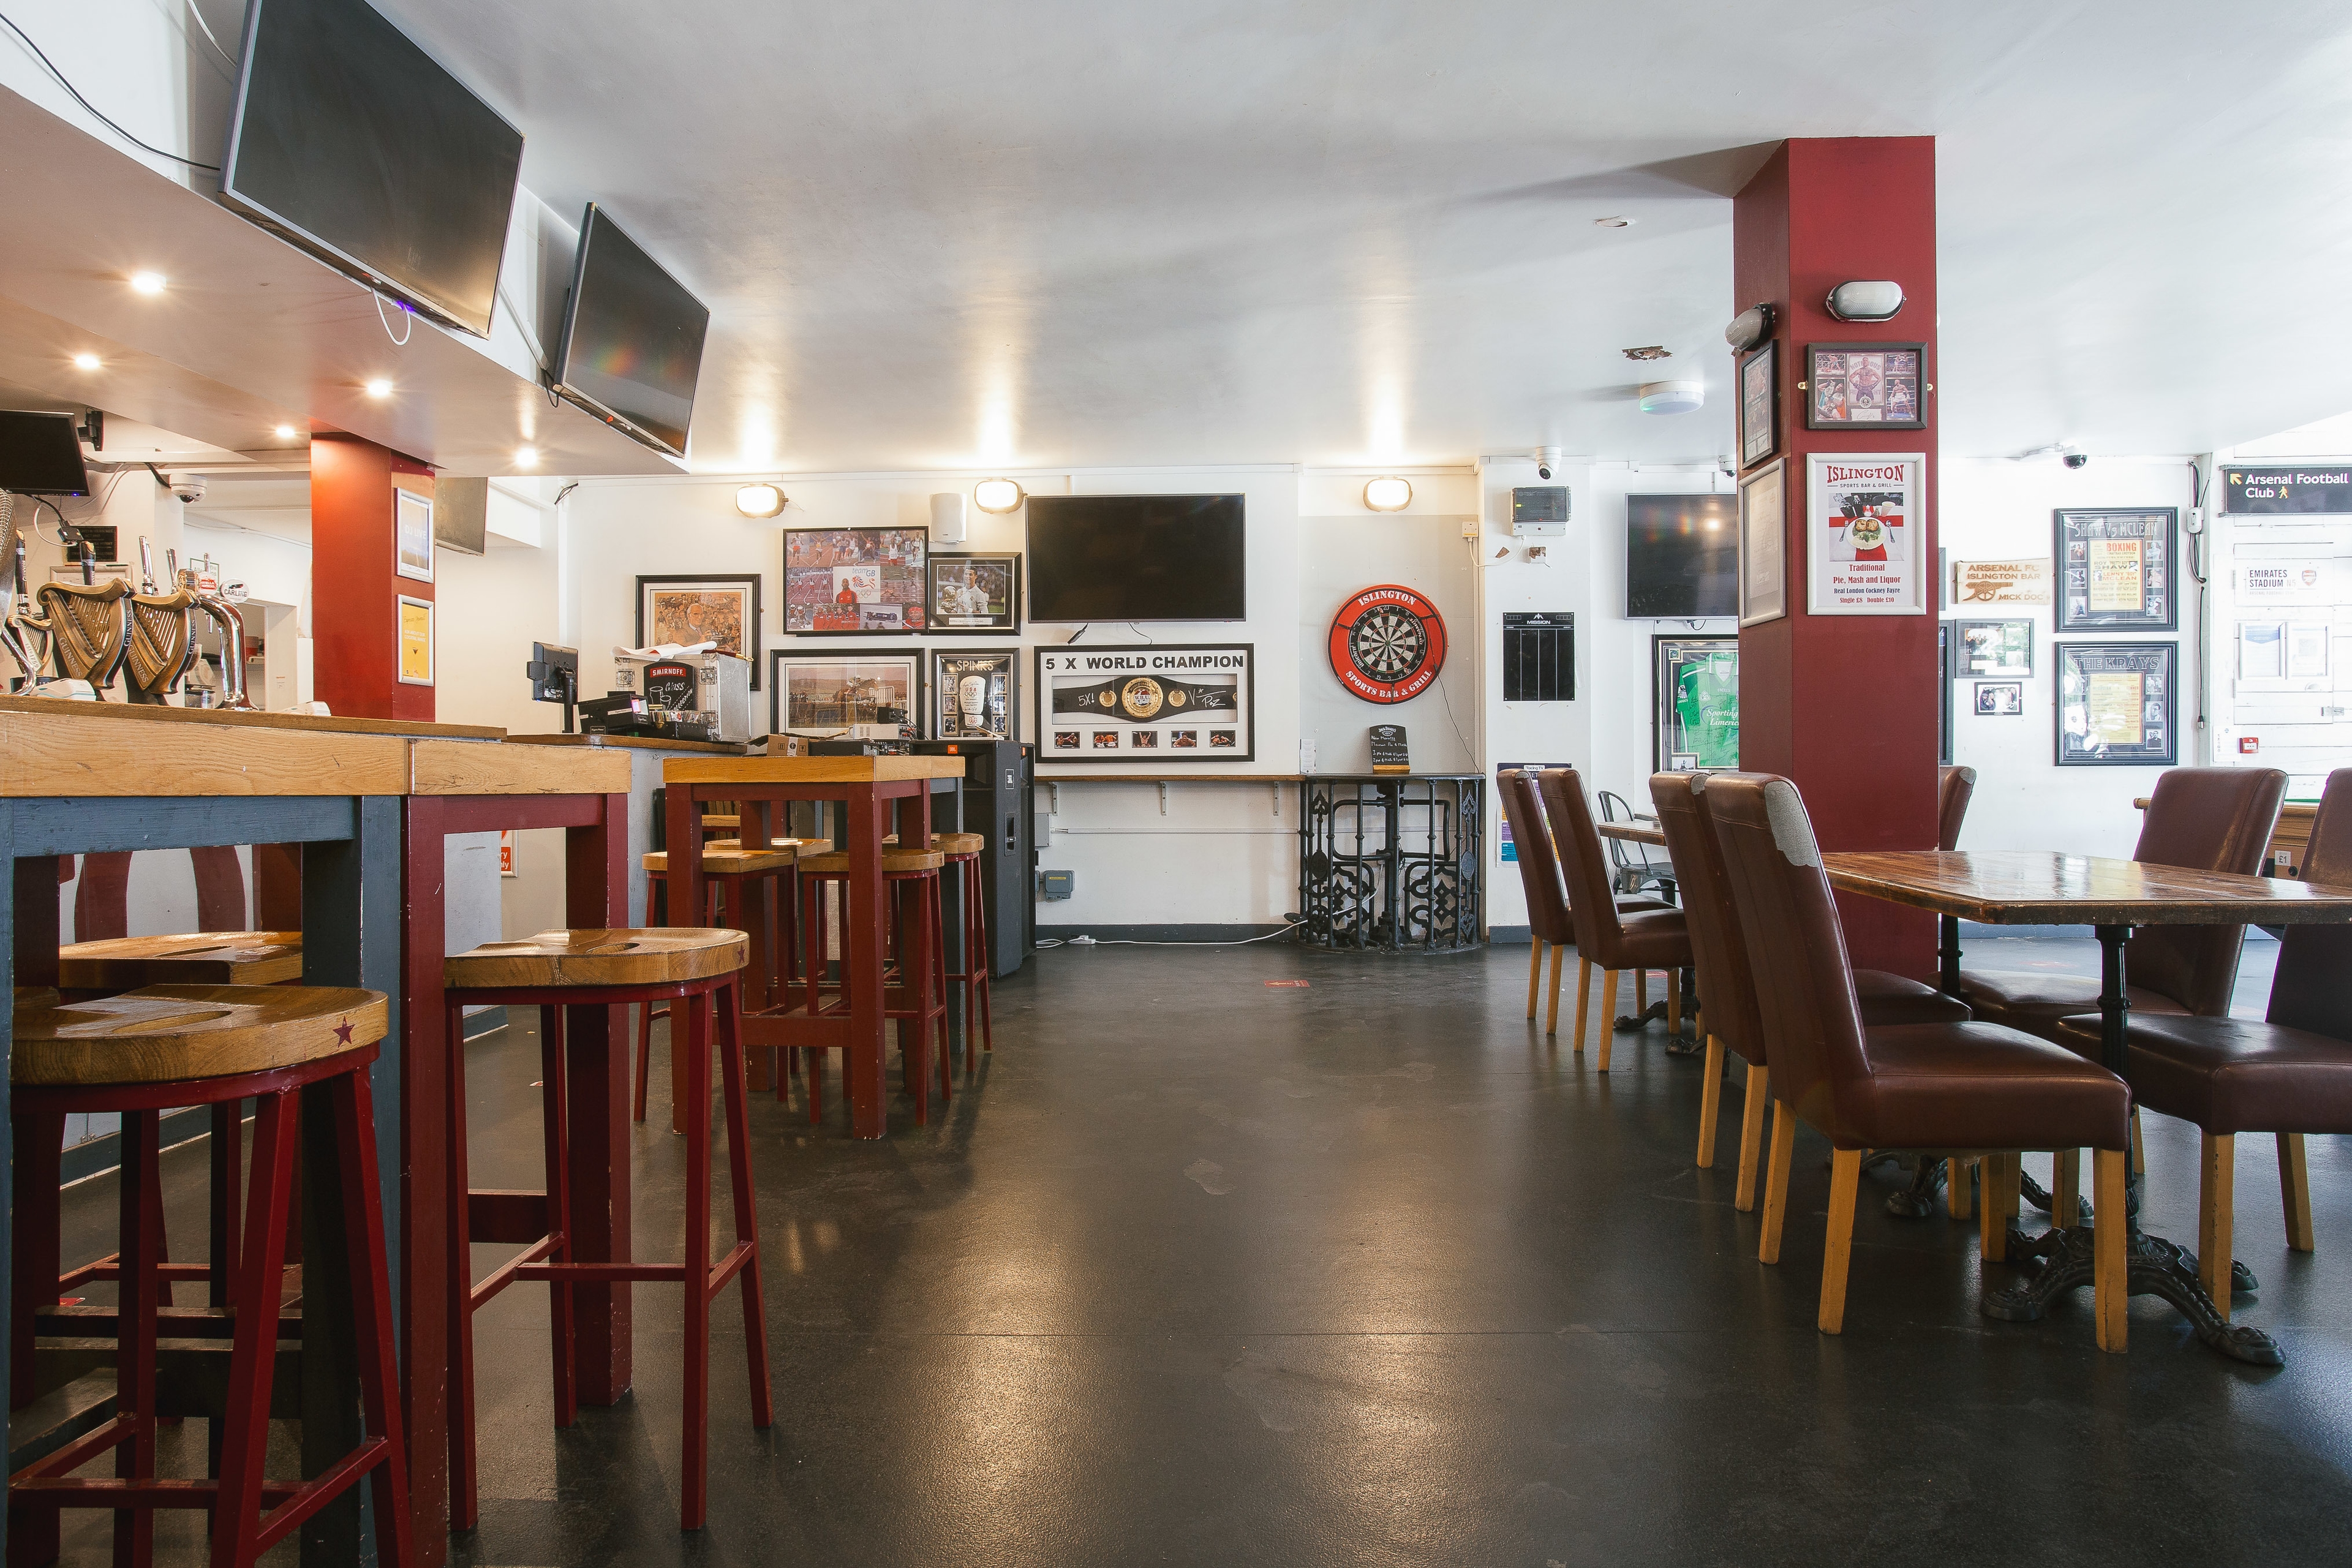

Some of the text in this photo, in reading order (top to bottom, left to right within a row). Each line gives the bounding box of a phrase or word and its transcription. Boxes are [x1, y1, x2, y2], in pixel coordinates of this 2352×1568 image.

[1826, 464, 1904, 483] ISLINGTON
[2245, 473, 2349, 484] Arsenal Football
[2245, 488, 2275, 499] Club
[405, 524, 427, 540] DJ LIVE
[2075, 522, 2157, 537] SHAW Vs MCLEAN
[2106, 542, 2137, 551] BOXING
[1880, 576, 1901, 584] Liquor
[2249, 569, 2288, 578] EMIRATES
[2249, 579, 2296, 587] STADIUM N5
[224, 589, 247, 597] CARLING
[1357, 590, 1417, 606] ISLINGTON
[1408, 617, 1423, 645] DYNAMITE
[59, 637, 83, 677] GUINNESS
[129, 644, 149, 683] GUINNESS
[1046, 655, 1245, 670] 5 X WORLD CHAMPION
[2074, 657, 2159, 670] THE KRAYS
[956, 660, 994, 671] SPINKS
[665, 681, 686, 692] Glass
[1345, 670, 1378, 696] SPORTS
[1401, 688, 1409, 696] &
[1408, 669, 1433, 690] GRILL
[672, 688, 693, 711] OLLECTION
[1077, 693, 1095, 707] 5X!
[1706, 708, 1739, 718] Sporting
[2278, 855, 2287, 864] £1
